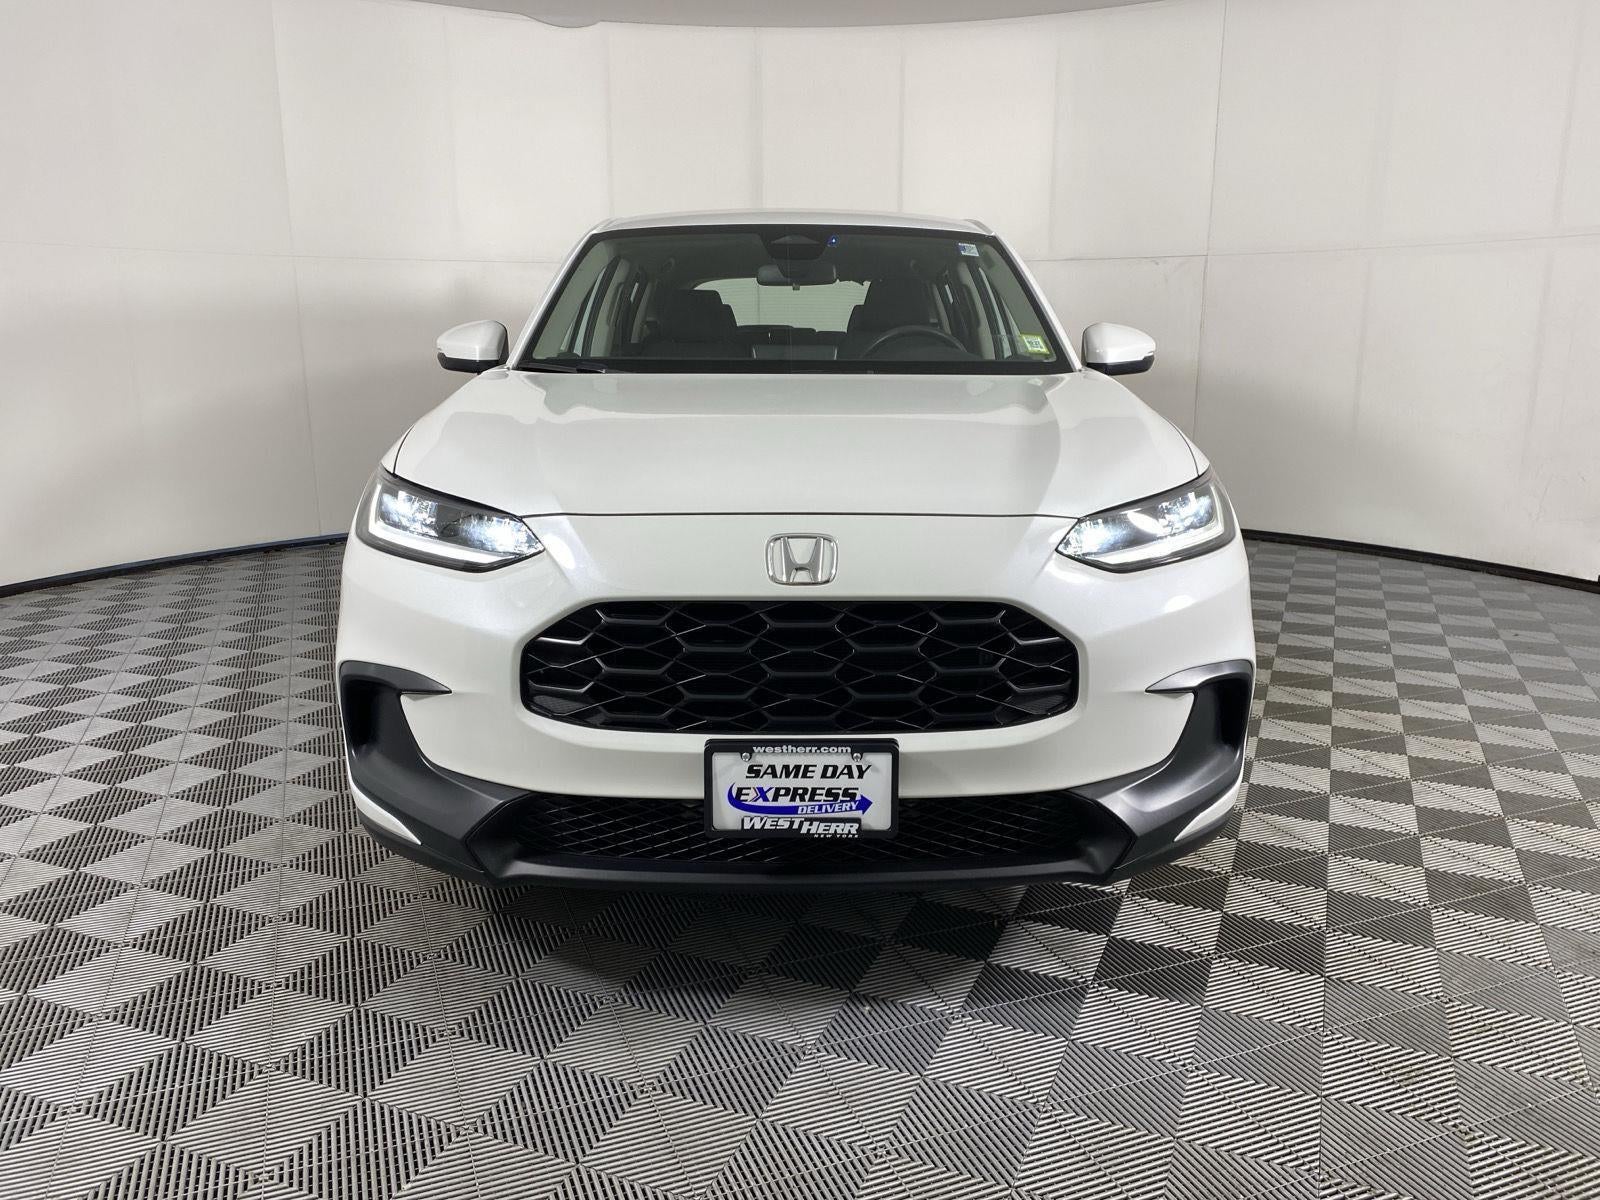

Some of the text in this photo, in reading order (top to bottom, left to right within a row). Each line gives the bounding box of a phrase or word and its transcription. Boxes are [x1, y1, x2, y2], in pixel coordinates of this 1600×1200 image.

[753, 745, 851, 753] westherr.com
[746, 764, 872, 779] SAME DAY
[735, 786, 859, 802] EXPRESS
[797, 801, 860, 815] DELIVERY
[743, 816, 860, 834] WEST HERR
